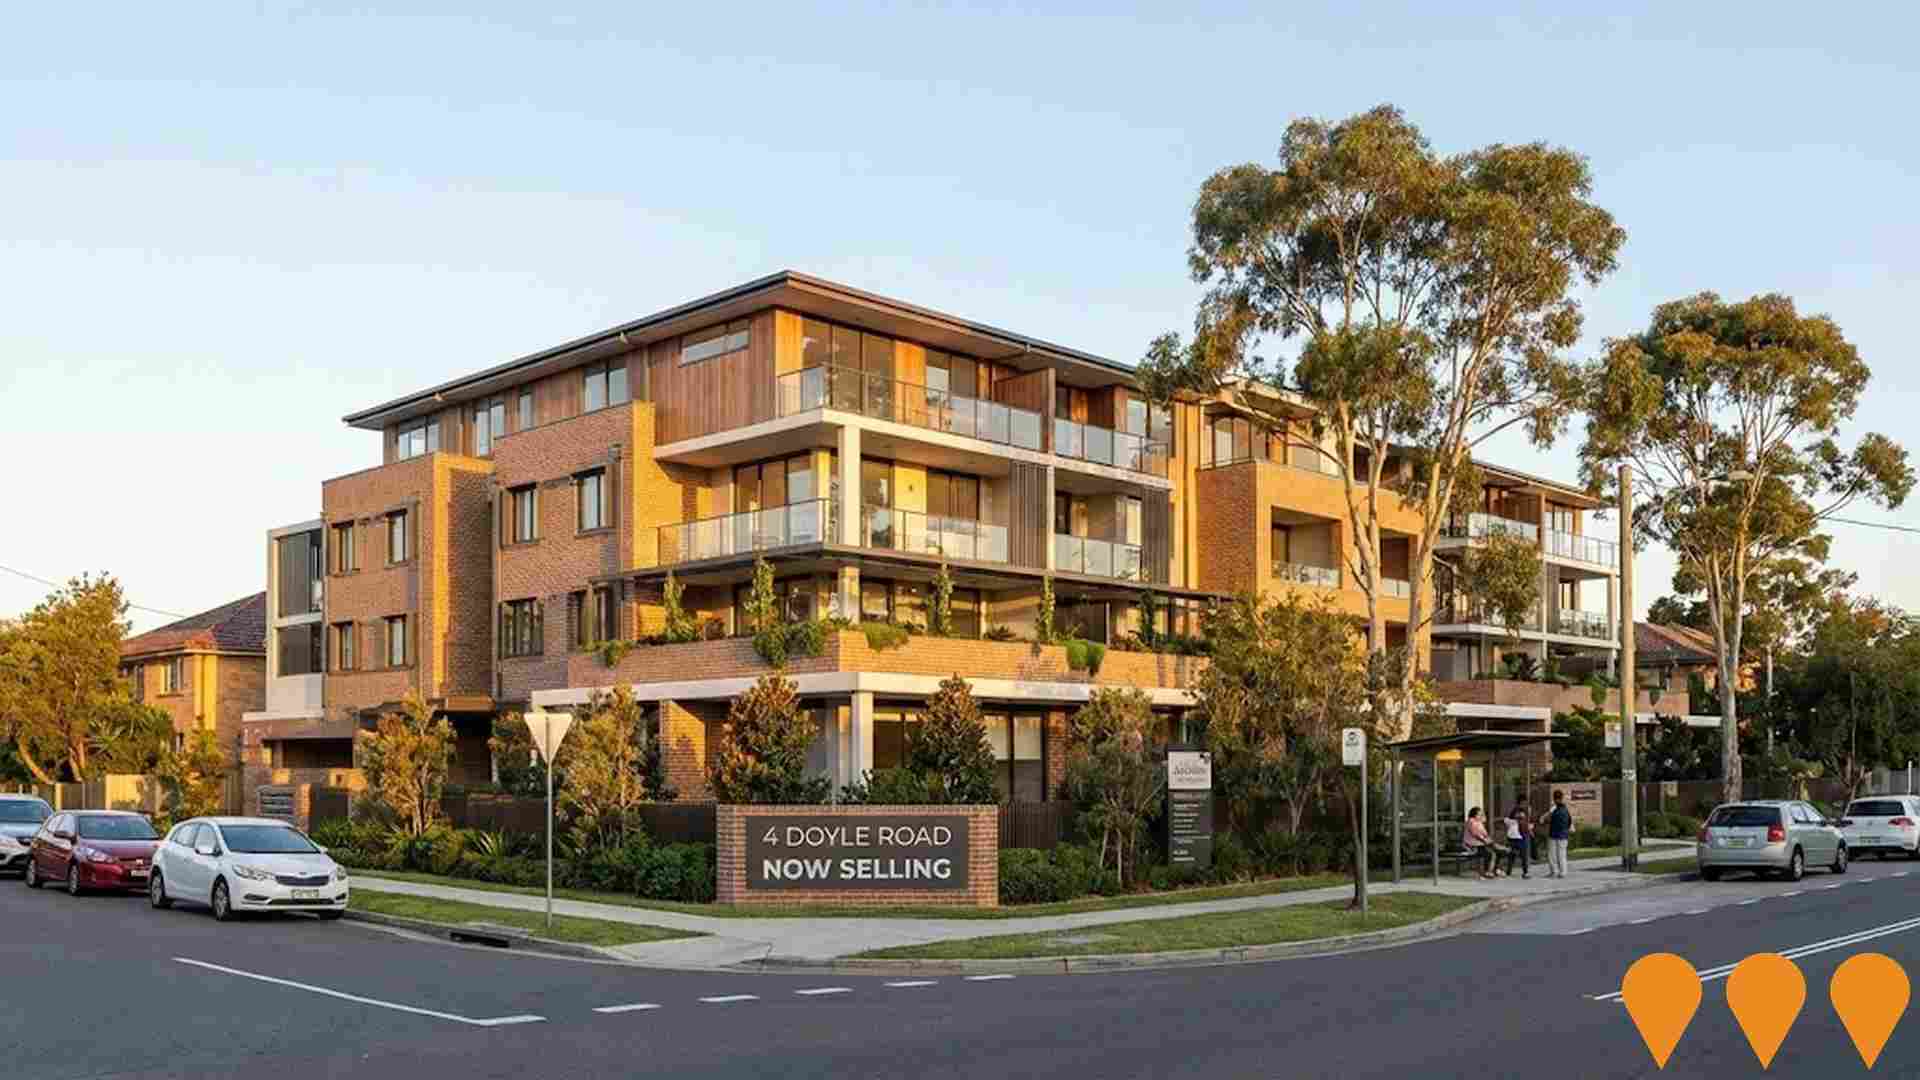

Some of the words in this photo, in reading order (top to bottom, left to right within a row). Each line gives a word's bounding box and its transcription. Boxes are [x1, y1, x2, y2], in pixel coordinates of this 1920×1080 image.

[762, 826, 779, 846] 4
[786, 826, 871, 846] DOYLE
[878, 826, 951, 846] ROAD
[763, 858, 832, 879] NOW
[839, 858, 951, 879] SELLING
